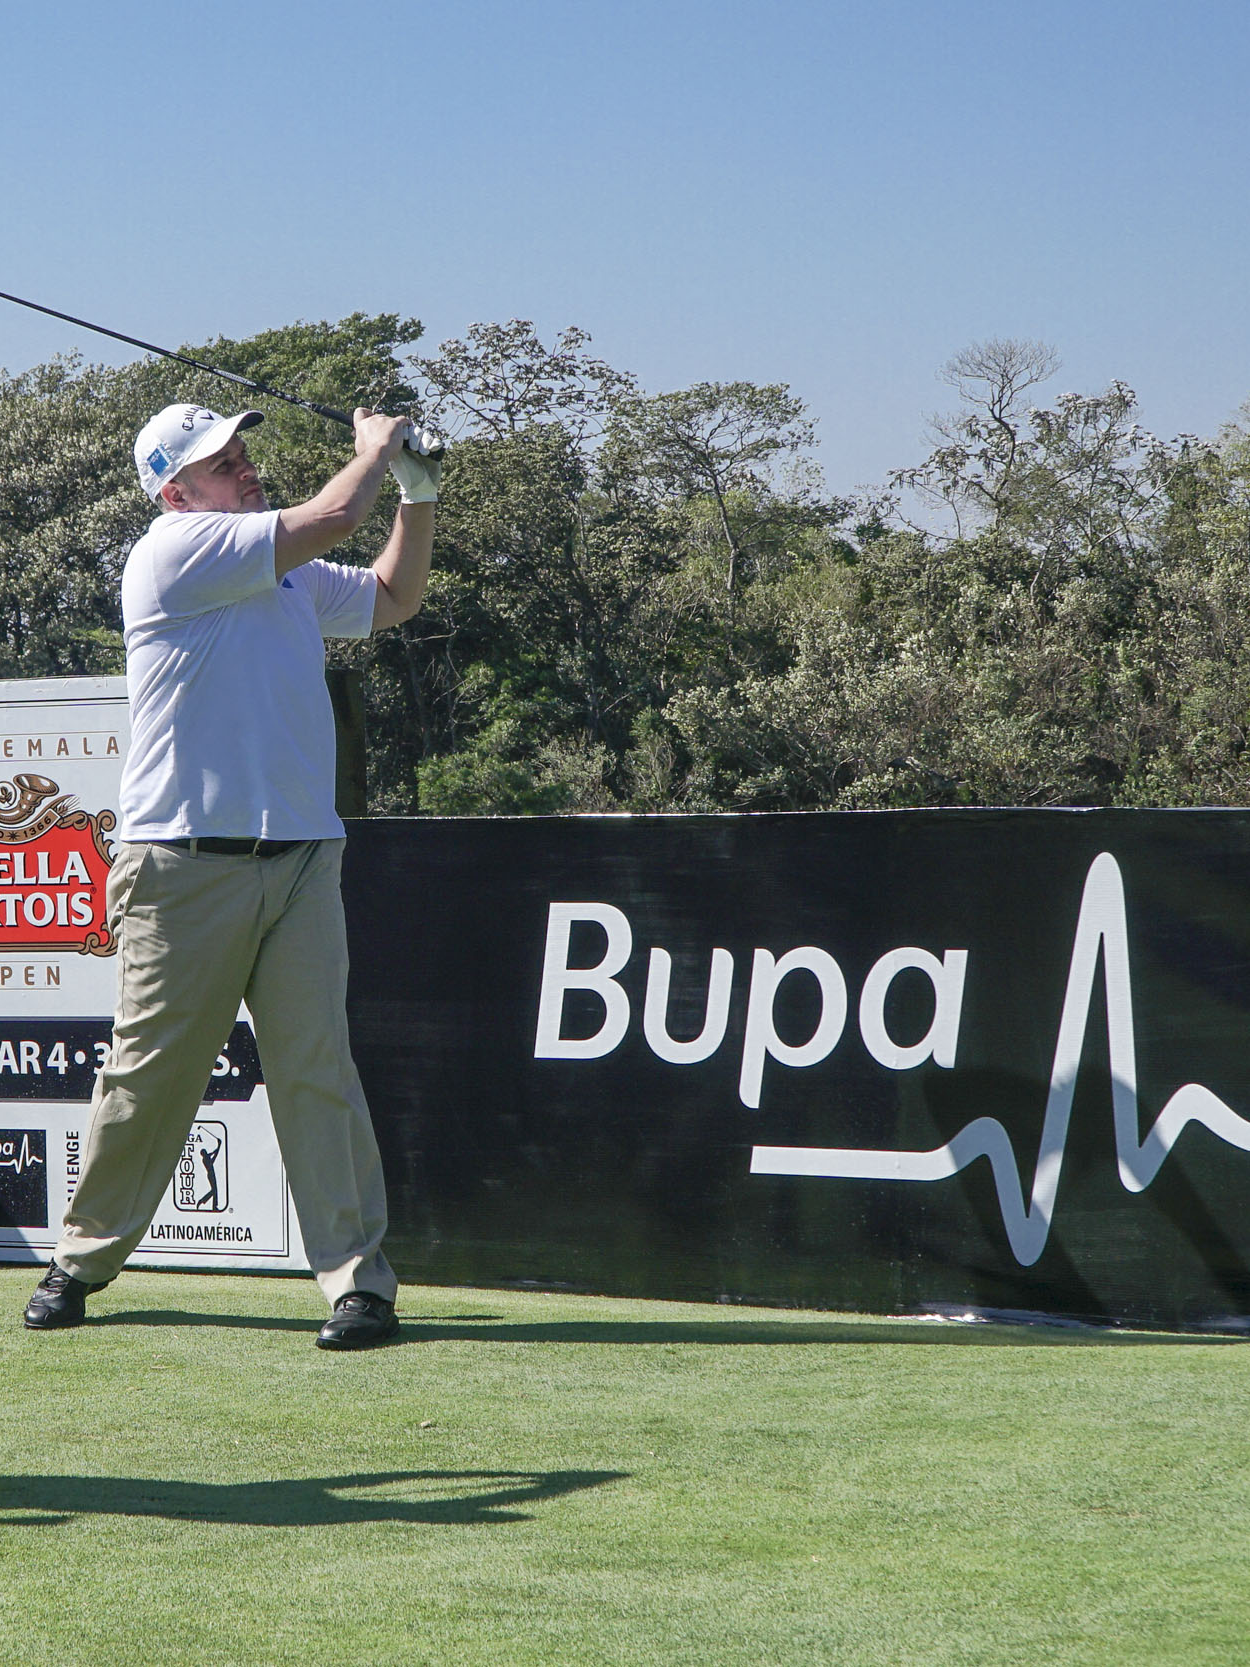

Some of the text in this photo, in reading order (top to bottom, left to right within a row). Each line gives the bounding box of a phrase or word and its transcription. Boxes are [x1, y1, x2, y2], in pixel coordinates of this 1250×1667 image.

[23, 816, 52, 838] 1366
[534, 902, 968, 1109] Bupa
[47, 1042, 69, 1075] 4
[93, 1041, 111, 1075] 3
[187, 1133, 203, 1143] GA
[180, 1144, 196, 1205] TOUR
[150, 1222, 253, 1242] LATINOAMÉRICA
